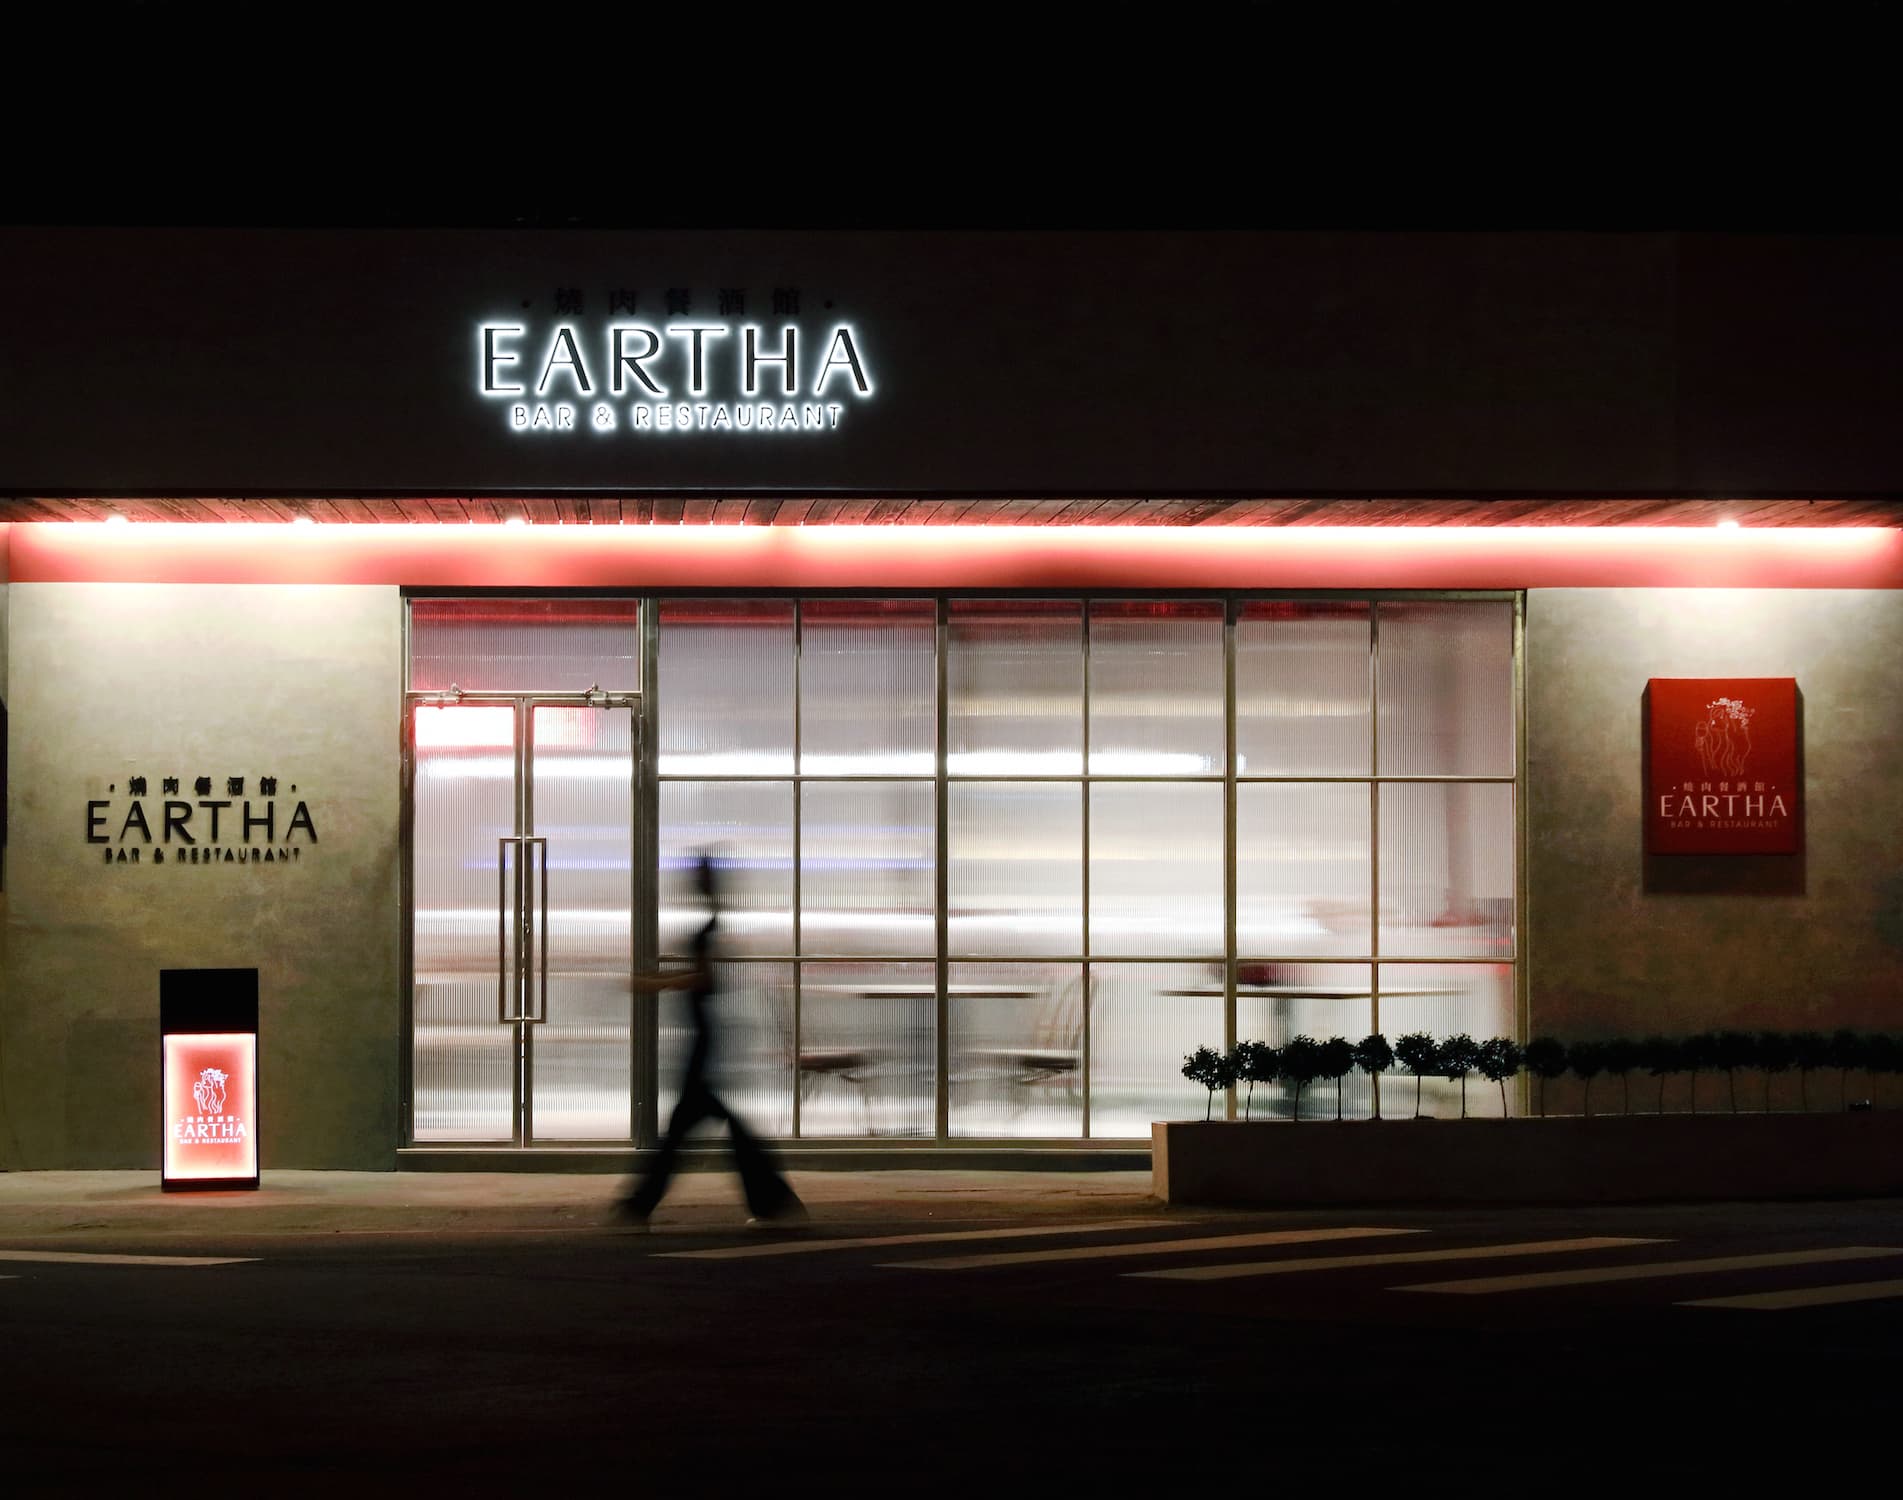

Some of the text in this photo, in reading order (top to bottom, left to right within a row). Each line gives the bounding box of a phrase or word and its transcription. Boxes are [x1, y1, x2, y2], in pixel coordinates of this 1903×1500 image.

[482, 326, 870, 395] EARTHA
[514, 405, 841, 427] BAR & RESTAURANT
[1660, 794, 1787, 818] EARTHA
[87, 801, 317, 844] EARTHA
[1670, 820, 1691, 829] BAR
[1710, 820, 1778, 829] RESTAURANT
[105, 848, 300, 864] BAR & RESTAURANT
[174, 1123, 247, 1137] EARTHA
